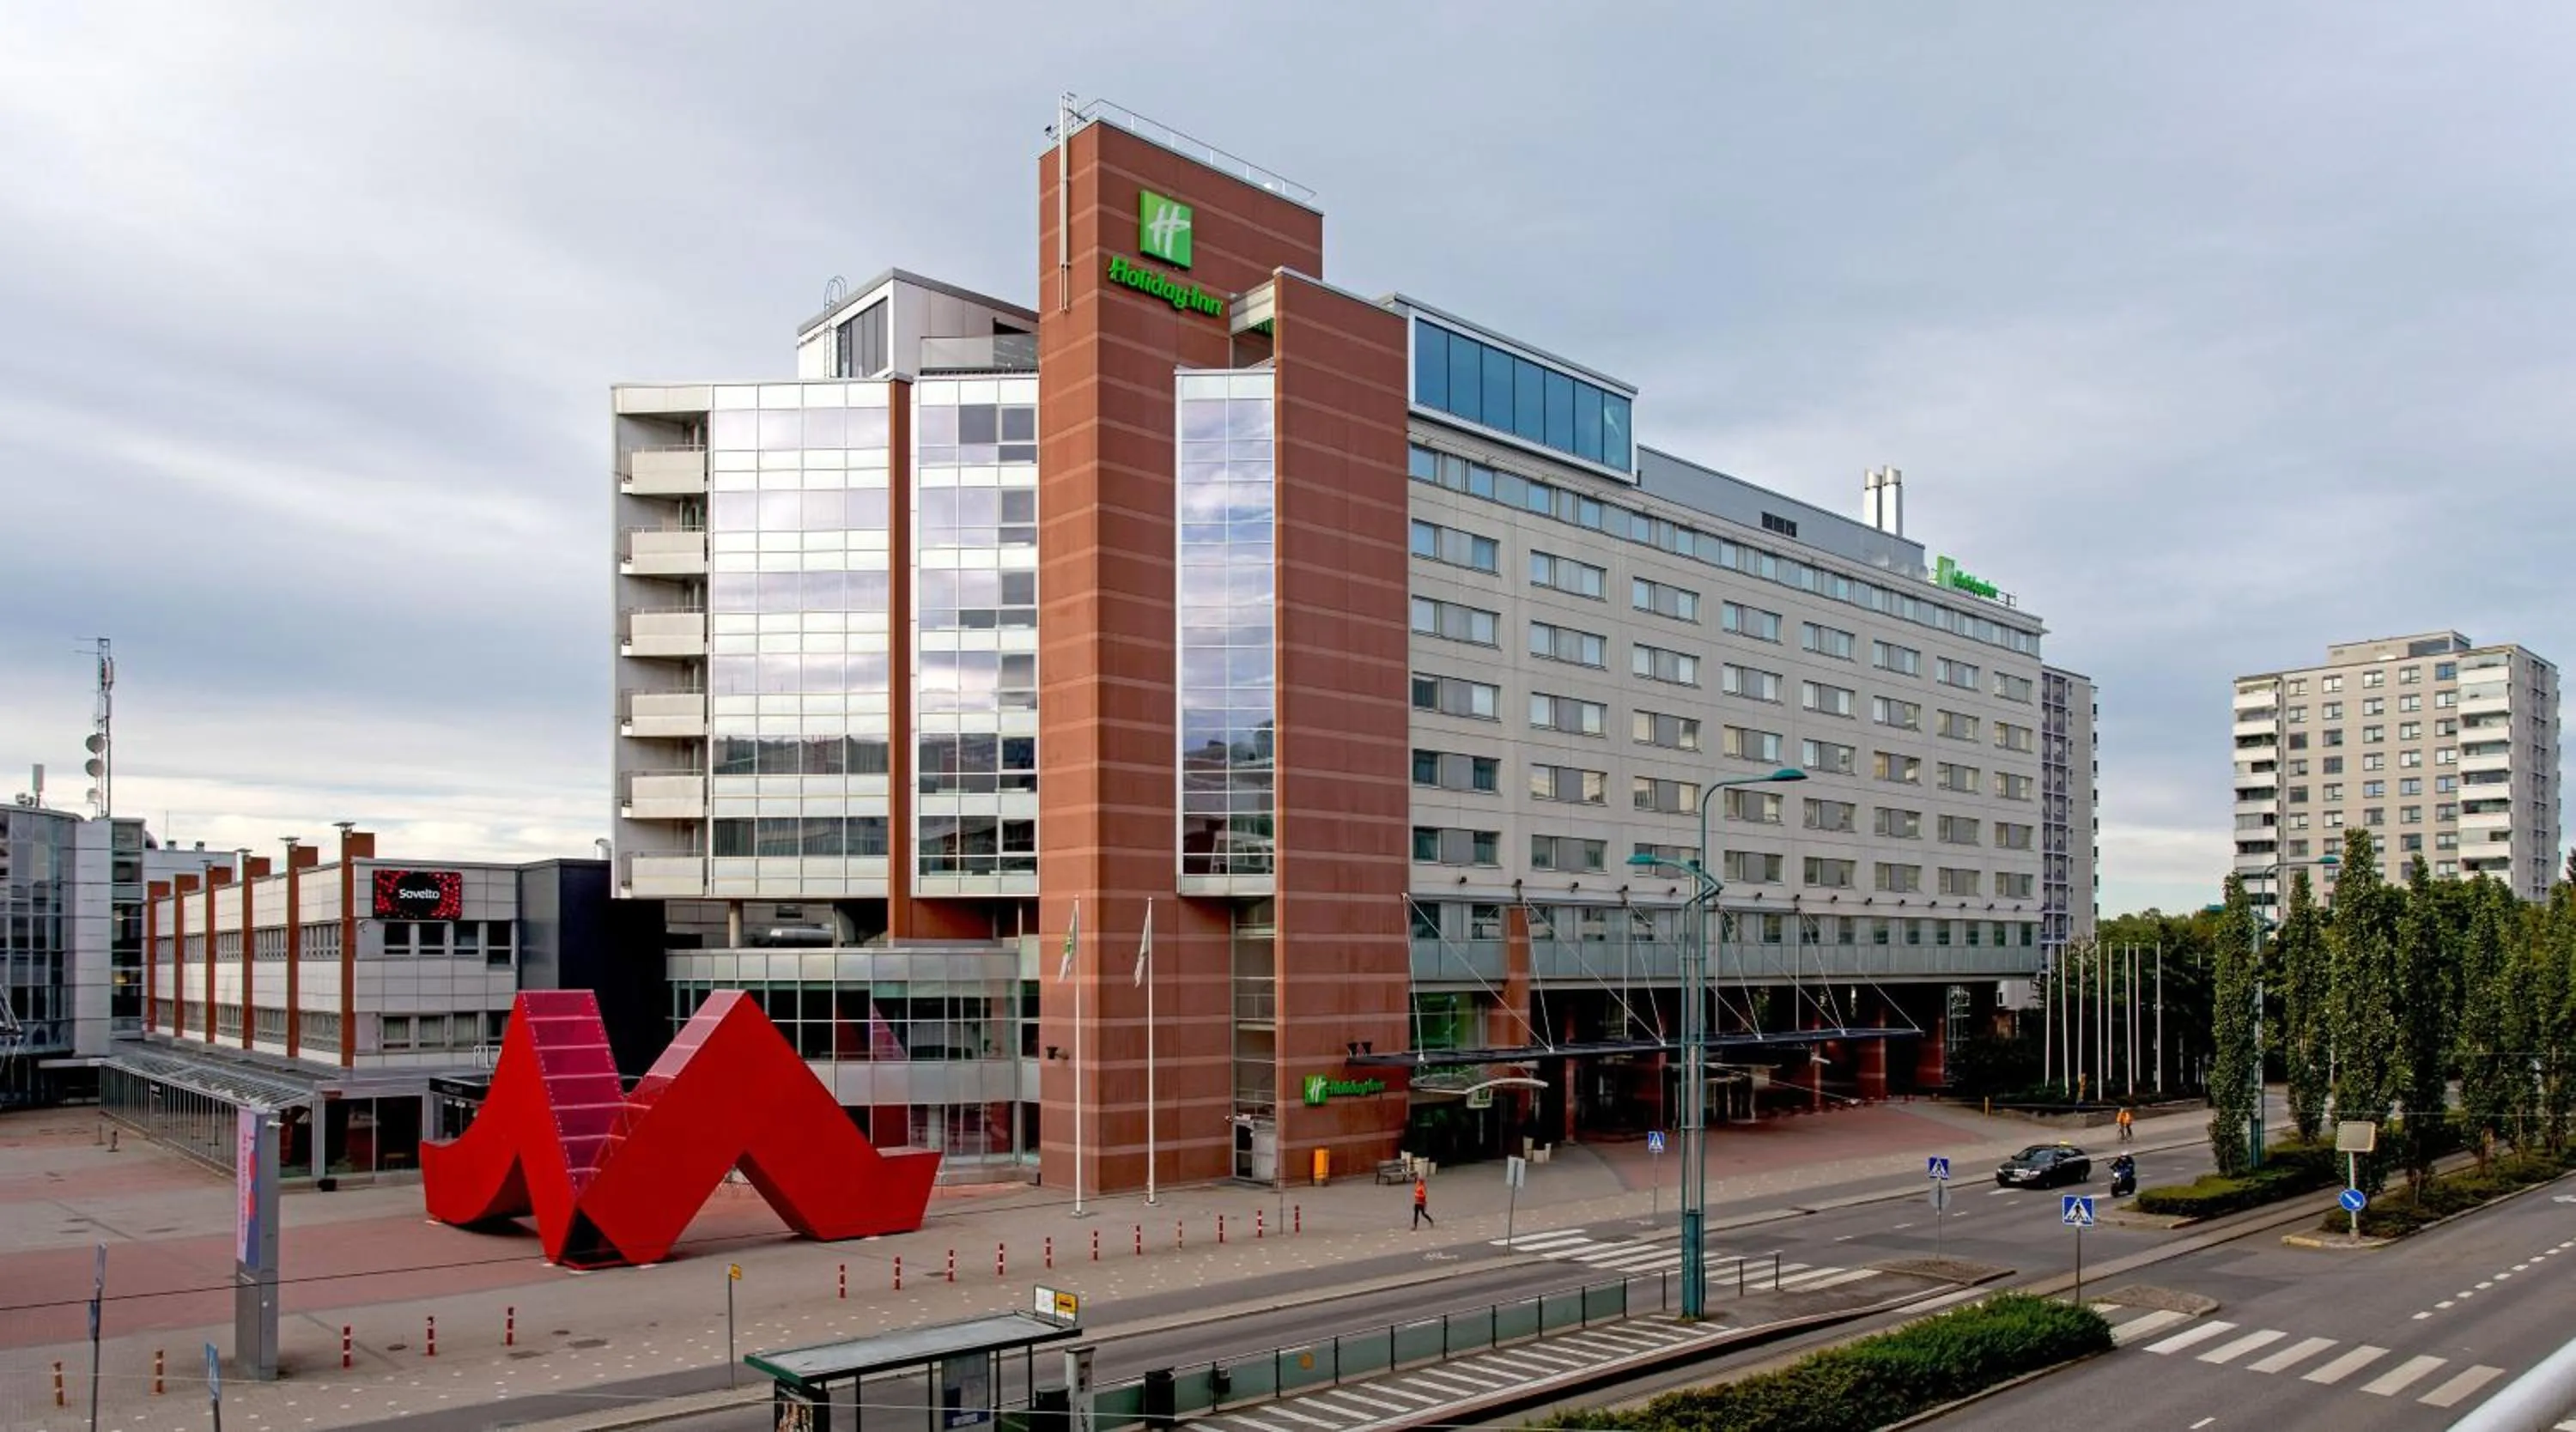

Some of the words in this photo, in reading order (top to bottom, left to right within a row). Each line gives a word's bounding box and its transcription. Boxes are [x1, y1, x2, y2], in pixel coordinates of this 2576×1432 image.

[1109, 256, 1188, 309] Holiday
[1189, 285, 1223, 316] Inn
[1328, 1079, 1368, 1096] Holiday
